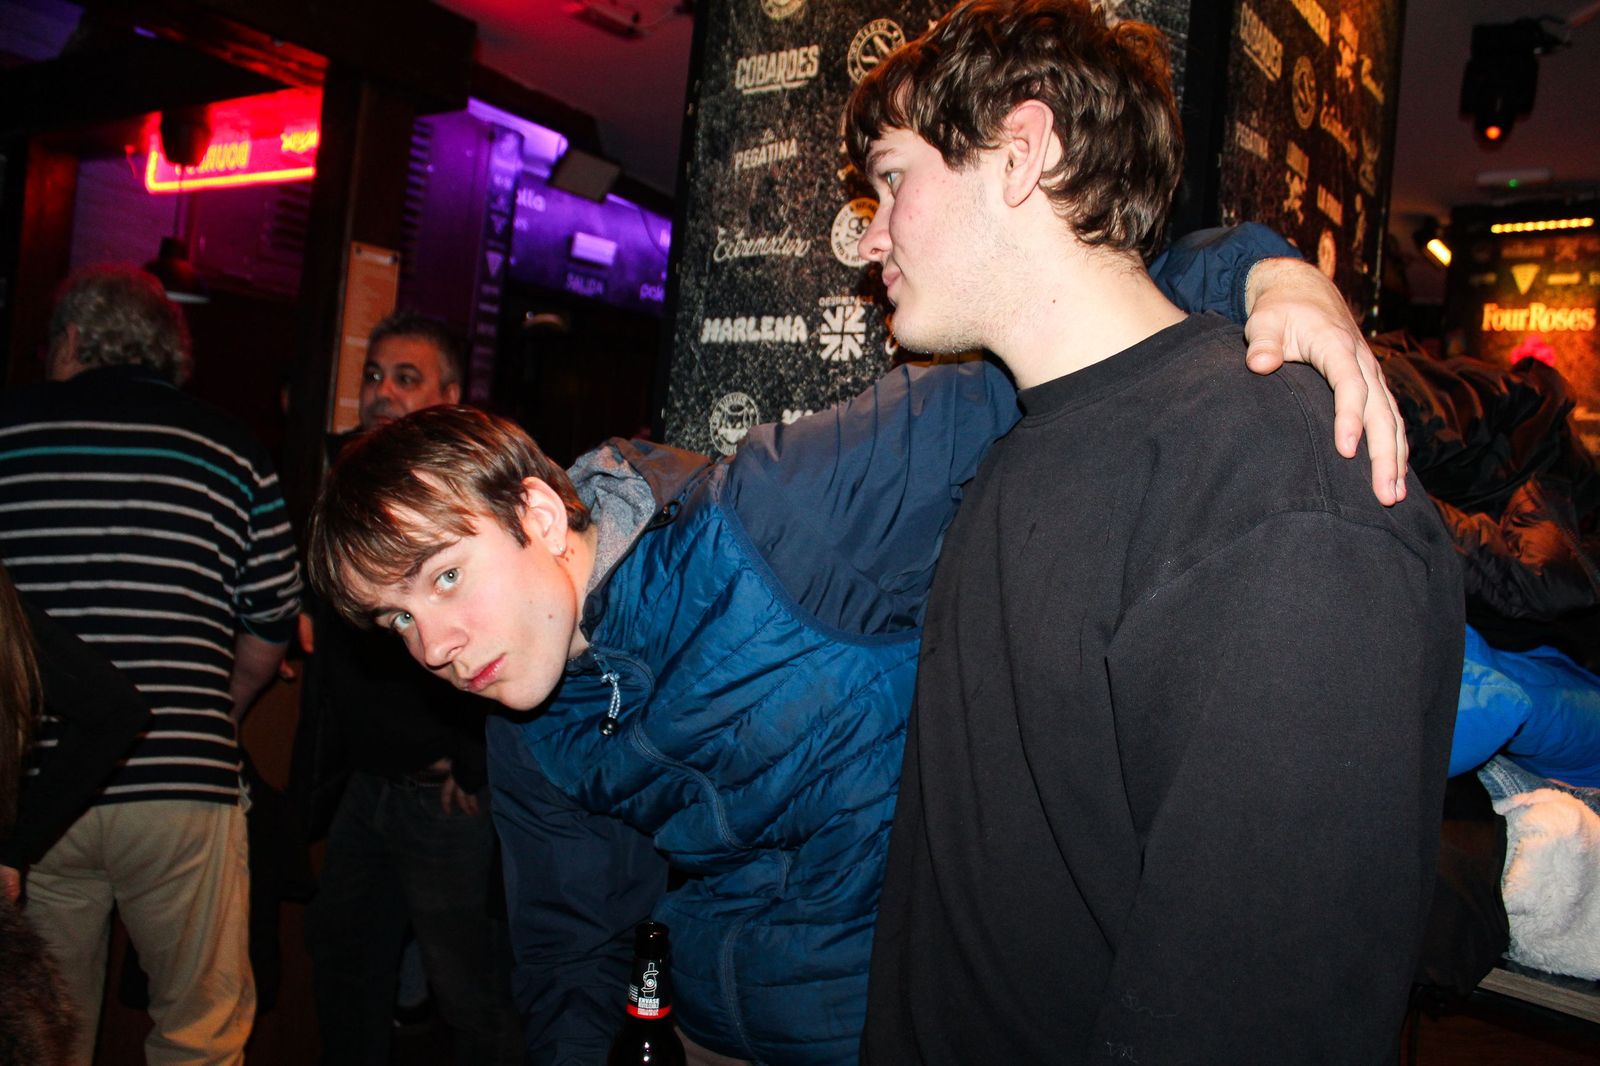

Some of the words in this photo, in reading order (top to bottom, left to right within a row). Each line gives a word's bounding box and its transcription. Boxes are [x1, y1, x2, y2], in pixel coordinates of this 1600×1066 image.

[735, 44, 820, 91] COBARDES
[734, 138, 798, 171] PEGATINA
[713, 225, 812, 264] Extremoduro
[1482, 303, 1529, 332] Four
[1529, 302, 1596, 332] Roses
